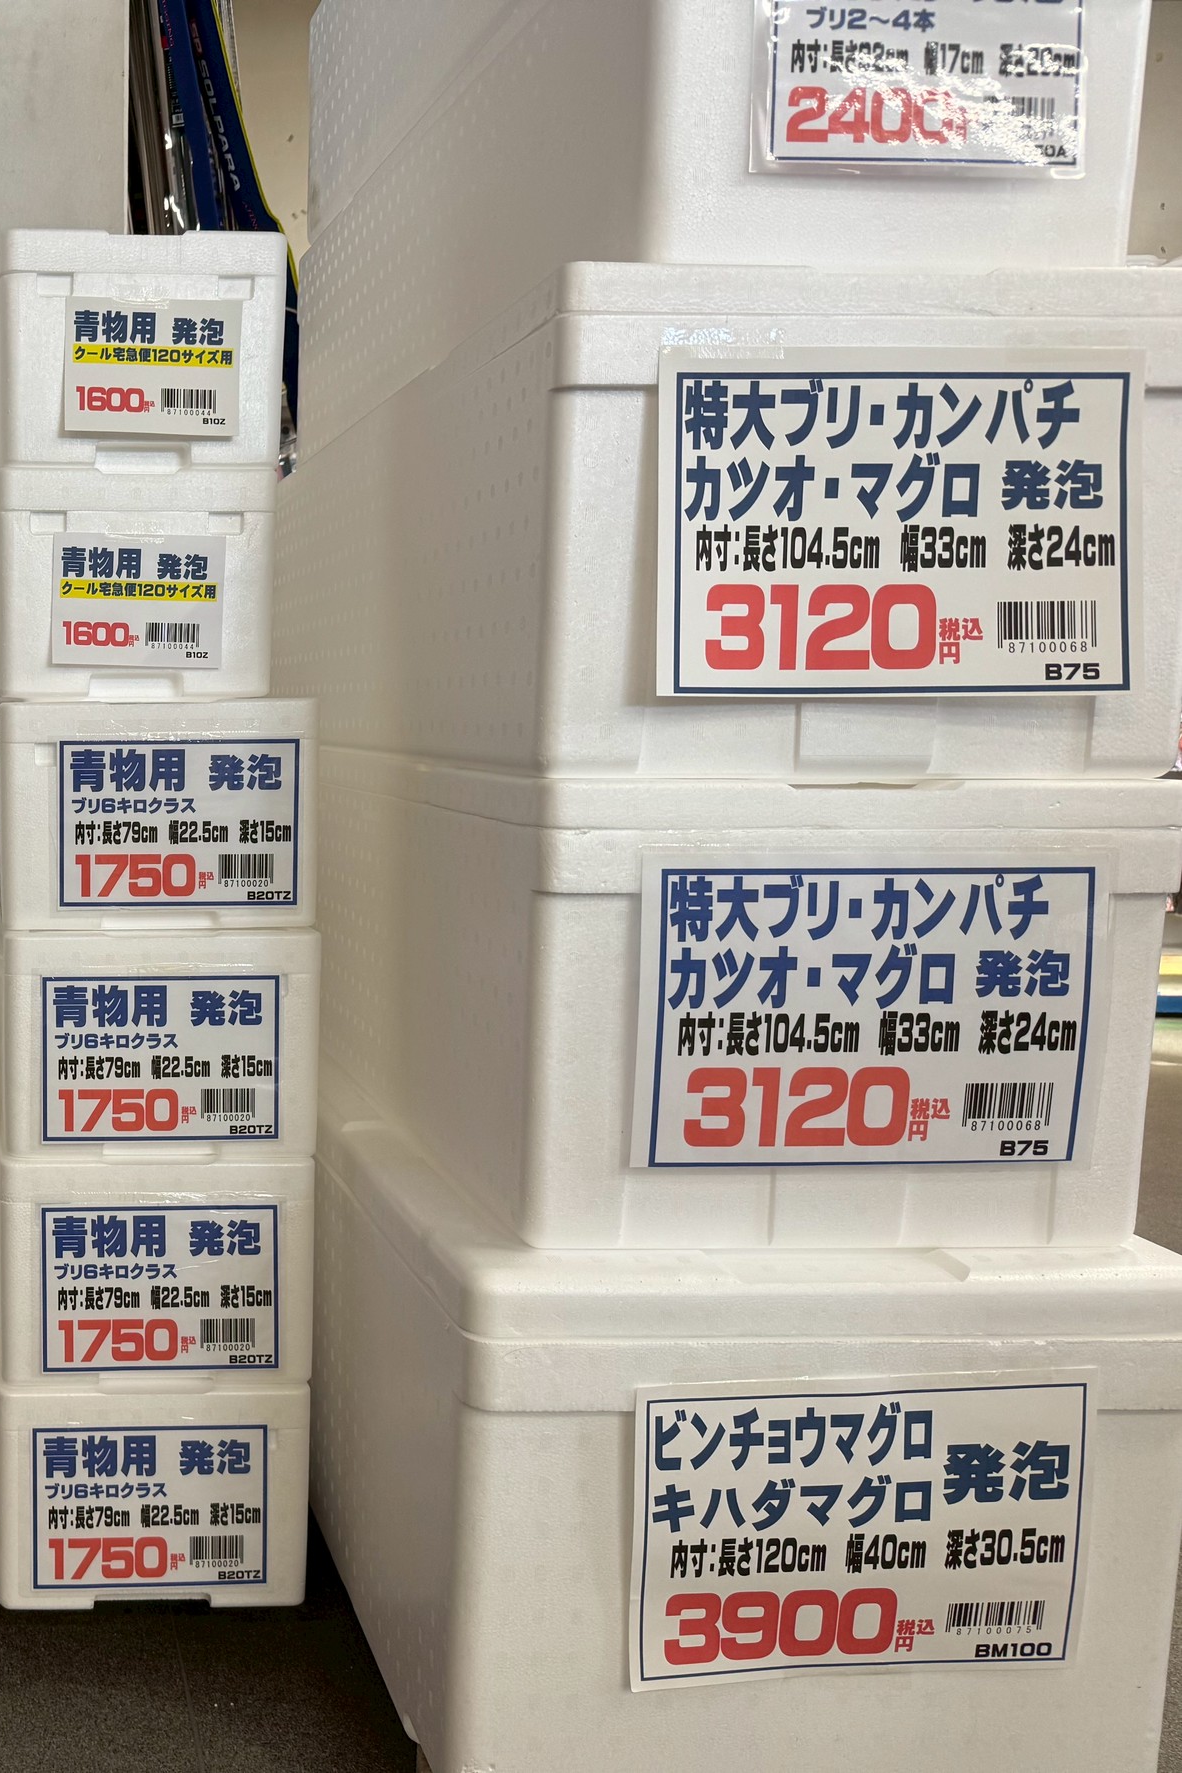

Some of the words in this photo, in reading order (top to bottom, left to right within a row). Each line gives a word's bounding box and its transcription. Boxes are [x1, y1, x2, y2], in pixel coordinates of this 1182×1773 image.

[74, 310, 155, 344] 青物用
[172, 318, 224, 346] 発泡
[76, 347, 233, 365] クール宅急便120サイズ用
[76, 387, 145, 413] 1600
[684, 378, 1080, 450] 特大ブリ・カンパチ
[684, 452, 980, 522] カツオ・マグロ
[1001, 459, 1103, 510] 発泡
[62, 546, 141, 579] 青物用
[157, 553, 207, 581] 発泡
[900, 524, 986, 572] 幅33cm
[1007, 523, 1115, 571] 深さ24cm
[63, 582, 217, 599] クール宅急便120サイズ用
[63, 622, 130, 647] 1600
[705, 584, 936, 670] 3120
[939, 618, 983, 641] 税込
[1009, 641, 1087, 653] 87100068
[1045, 663, 1100, 680] B75
[70, 749, 185, 792] 青物用
[209, 754, 282, 791] 発泡
[72, 797, 196, 814] ブリ6キロクラス
[169, 820, 228, 844] 幅22.5cm
[239, 819, 291, 844] 深さ15cm
[75, 854, 196, 897] 1750
[247, 891, 291, 900] B20TZ
[670, 874, 1047, 942] 特大ブリ・カンパチ
[669, 944, 954, 1009] カツオ・マグロ
[974, 951, 1068, 998] 発泡
[53, 985, 167, 1028] 青物用
[191, 990, 263, 1027] 発泡
[55, 1032, 178, 1049] ブリ6キロクラス
[878, 1011, 960, 1055] 幅33cm
[979, 1010, 1079, 1054] 深さ24cm
[152, 1055, 210, 1079] 幅22.5cm
[221, 1054, 272, 1079] 深さ15cm
[58, 1089, 179, 1132] 1750
[683, 1066, 910, 1147] 3120
[910, 1098, 950, 1120] 税込
[970, 1120, 1041, 1131] 87100068
[999, 1140, 1049, 1156] B75
[52, 1215, 166, 1258] 青物用
[189, 1220, 261, 1257] 発泡
[54, 1263, 177, 1280] ブリ6キロクラス
[151, 1285, 209, 1309] 幅22.5cm
[220, 1284, 271, 1309] 深さ15cm
[58, 1319, 179, 1362] 1750
[655, 1402, 932, 1471] ビンチョウマグロ
[42, 1435, 156, 1478] 青物用
[180, 1440, 251, 1476] 発泡
[943, 1440, 1070, 1505] 発泡
[45, 1482, 167, 1499] ブリ6キロクラス
[652, 1475, 932, 1533] キハダマグロ
[141, 1504, 199, 1527] 幅22.5cm
[210, 1502, 260, 1526] 深さ15cm
[48, 1537, 168, 1580] 1750
[845, 1534, 926, 1573] 幅40cm
[944, 1528, 1065, 1570] 深さ30.5cm
[664, 1588, 899, 1667] 3900
[897, 1619, 934, 1635] 税込
[956, 1624, 1031, 1635] 87100075
[975, 1642, 1052, 1657] BM100
